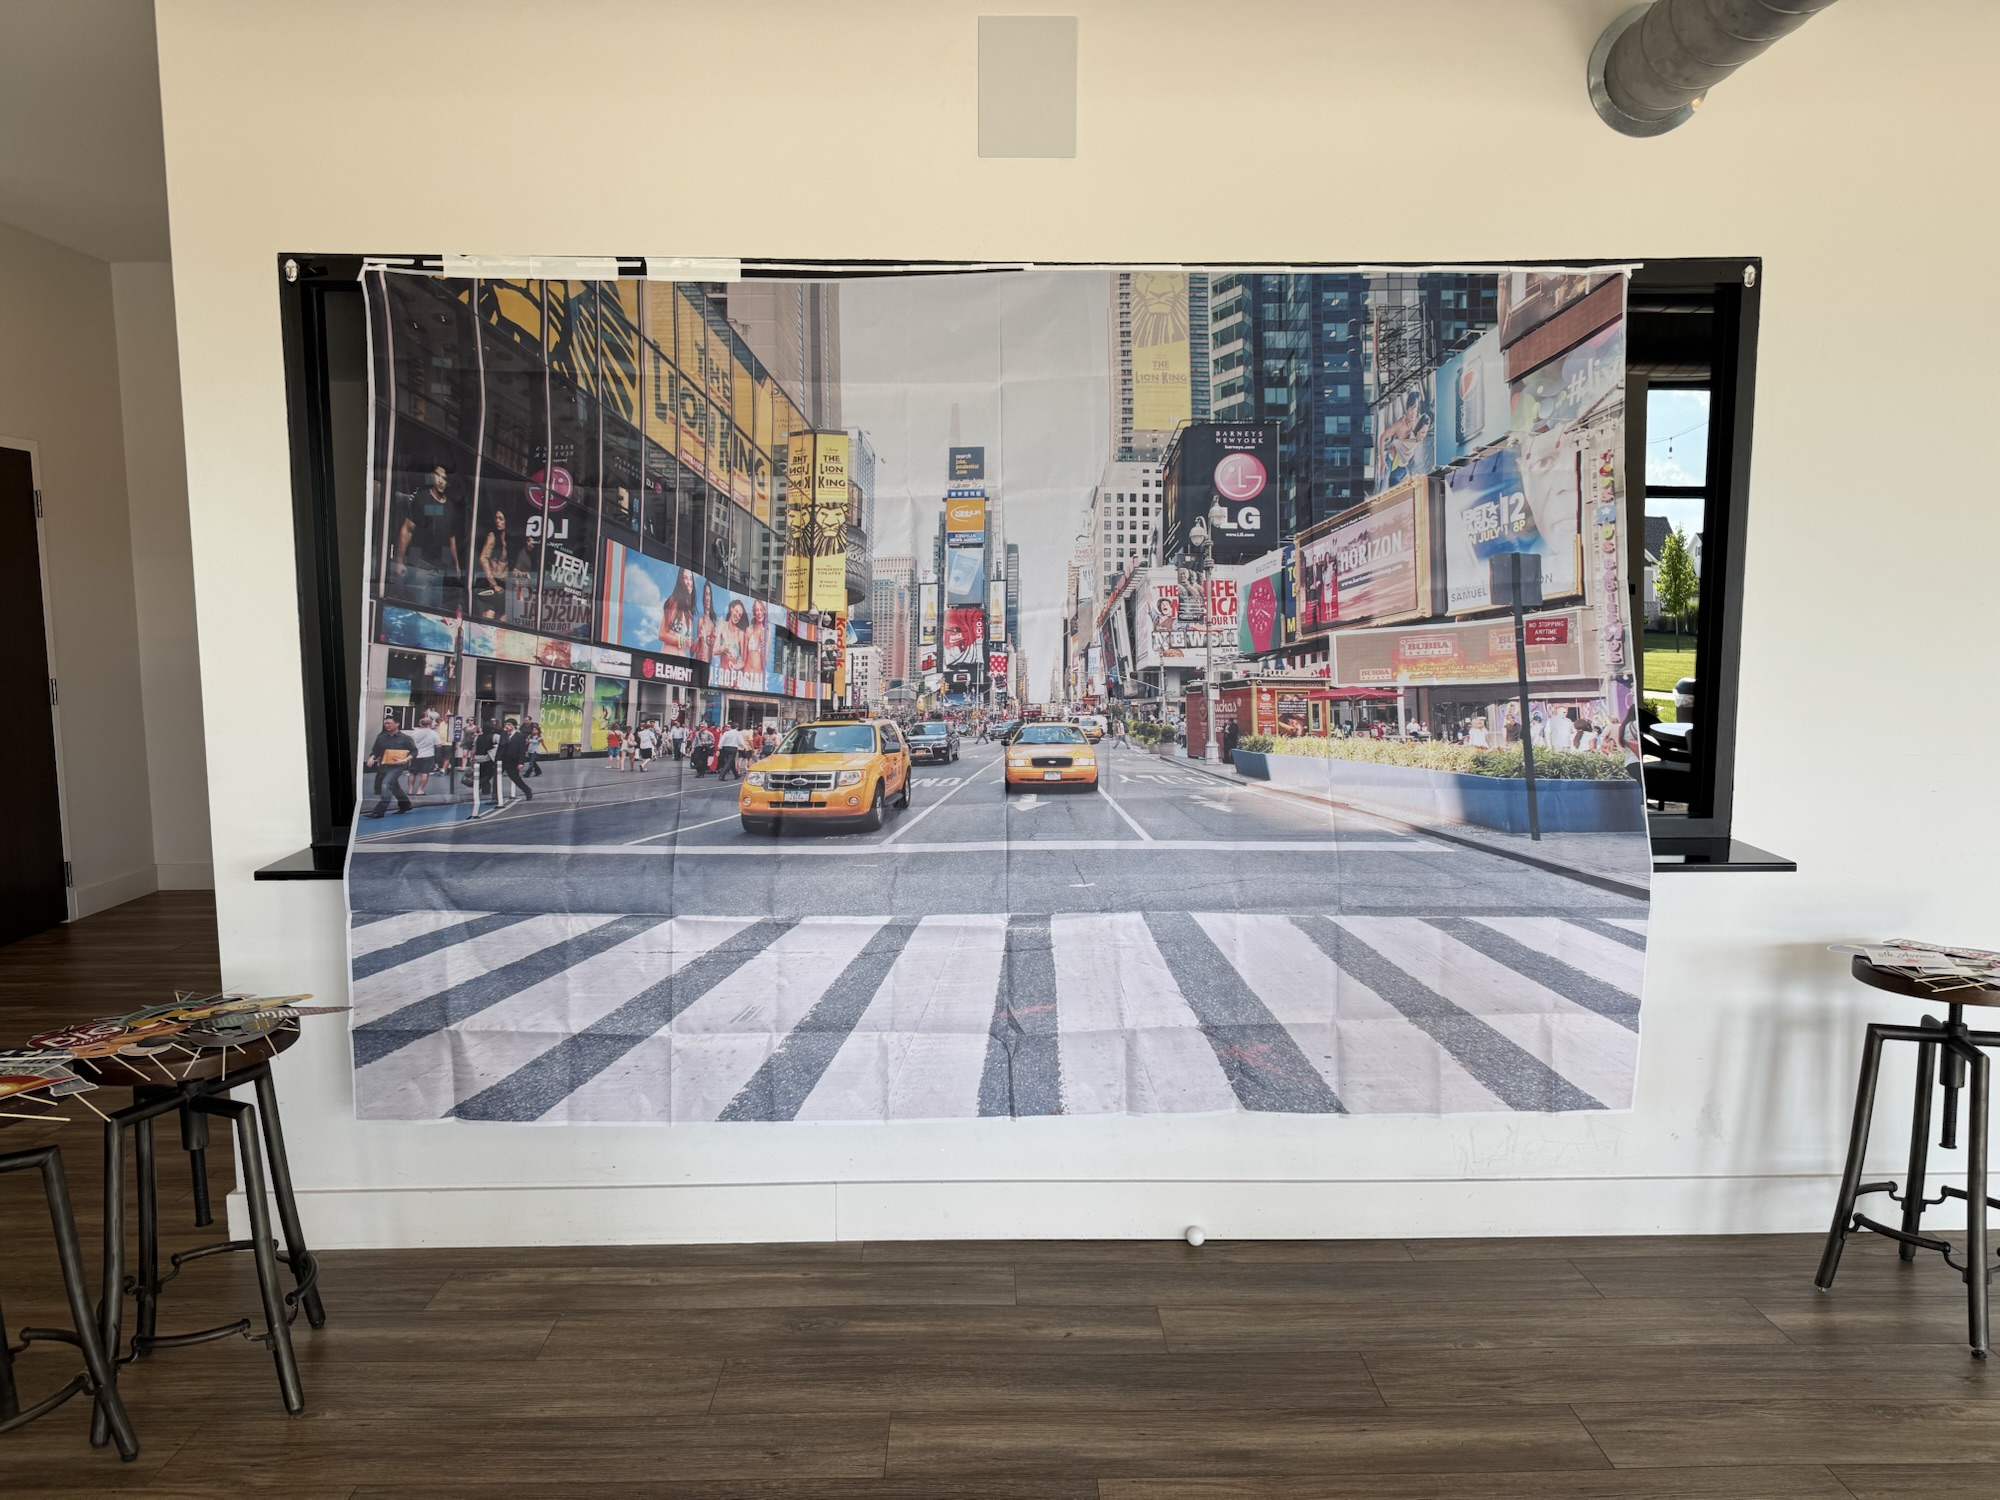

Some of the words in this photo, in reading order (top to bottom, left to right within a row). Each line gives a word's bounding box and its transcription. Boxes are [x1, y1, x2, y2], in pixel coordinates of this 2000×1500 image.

[1152, 360, 1169, 368] THE
[1135, 371, 1159, 384] LION
[1162, 371, 1187, 384] KING
[820, 463, 843, 474] LION
[818, 476, 846, 489] KING
[1219, 506, 1261, 530] LG
[1478, 526, 1501, 543] JULY
[1341, 530, 1402, 571] HORIZON
[554, 550, 589, 577] TEEN
[550, 565, 590, 590] WOLF
[1451, 587, 1487, 602] SAMUEL
[1538, 620, 1564, 629] STOPPING
[1407, 642, 1450, 651] BUBBA
[1530, 660, 1556, 668] BUBBA
[655, 662, 693, 683] ELEMENT
[541, 670, 586, 694] LIFE'S
[541, 694, 572, 706] BETTER
[1214, 699, 1238, 713] uchas
[539, 708, 583, 727] BOARD
